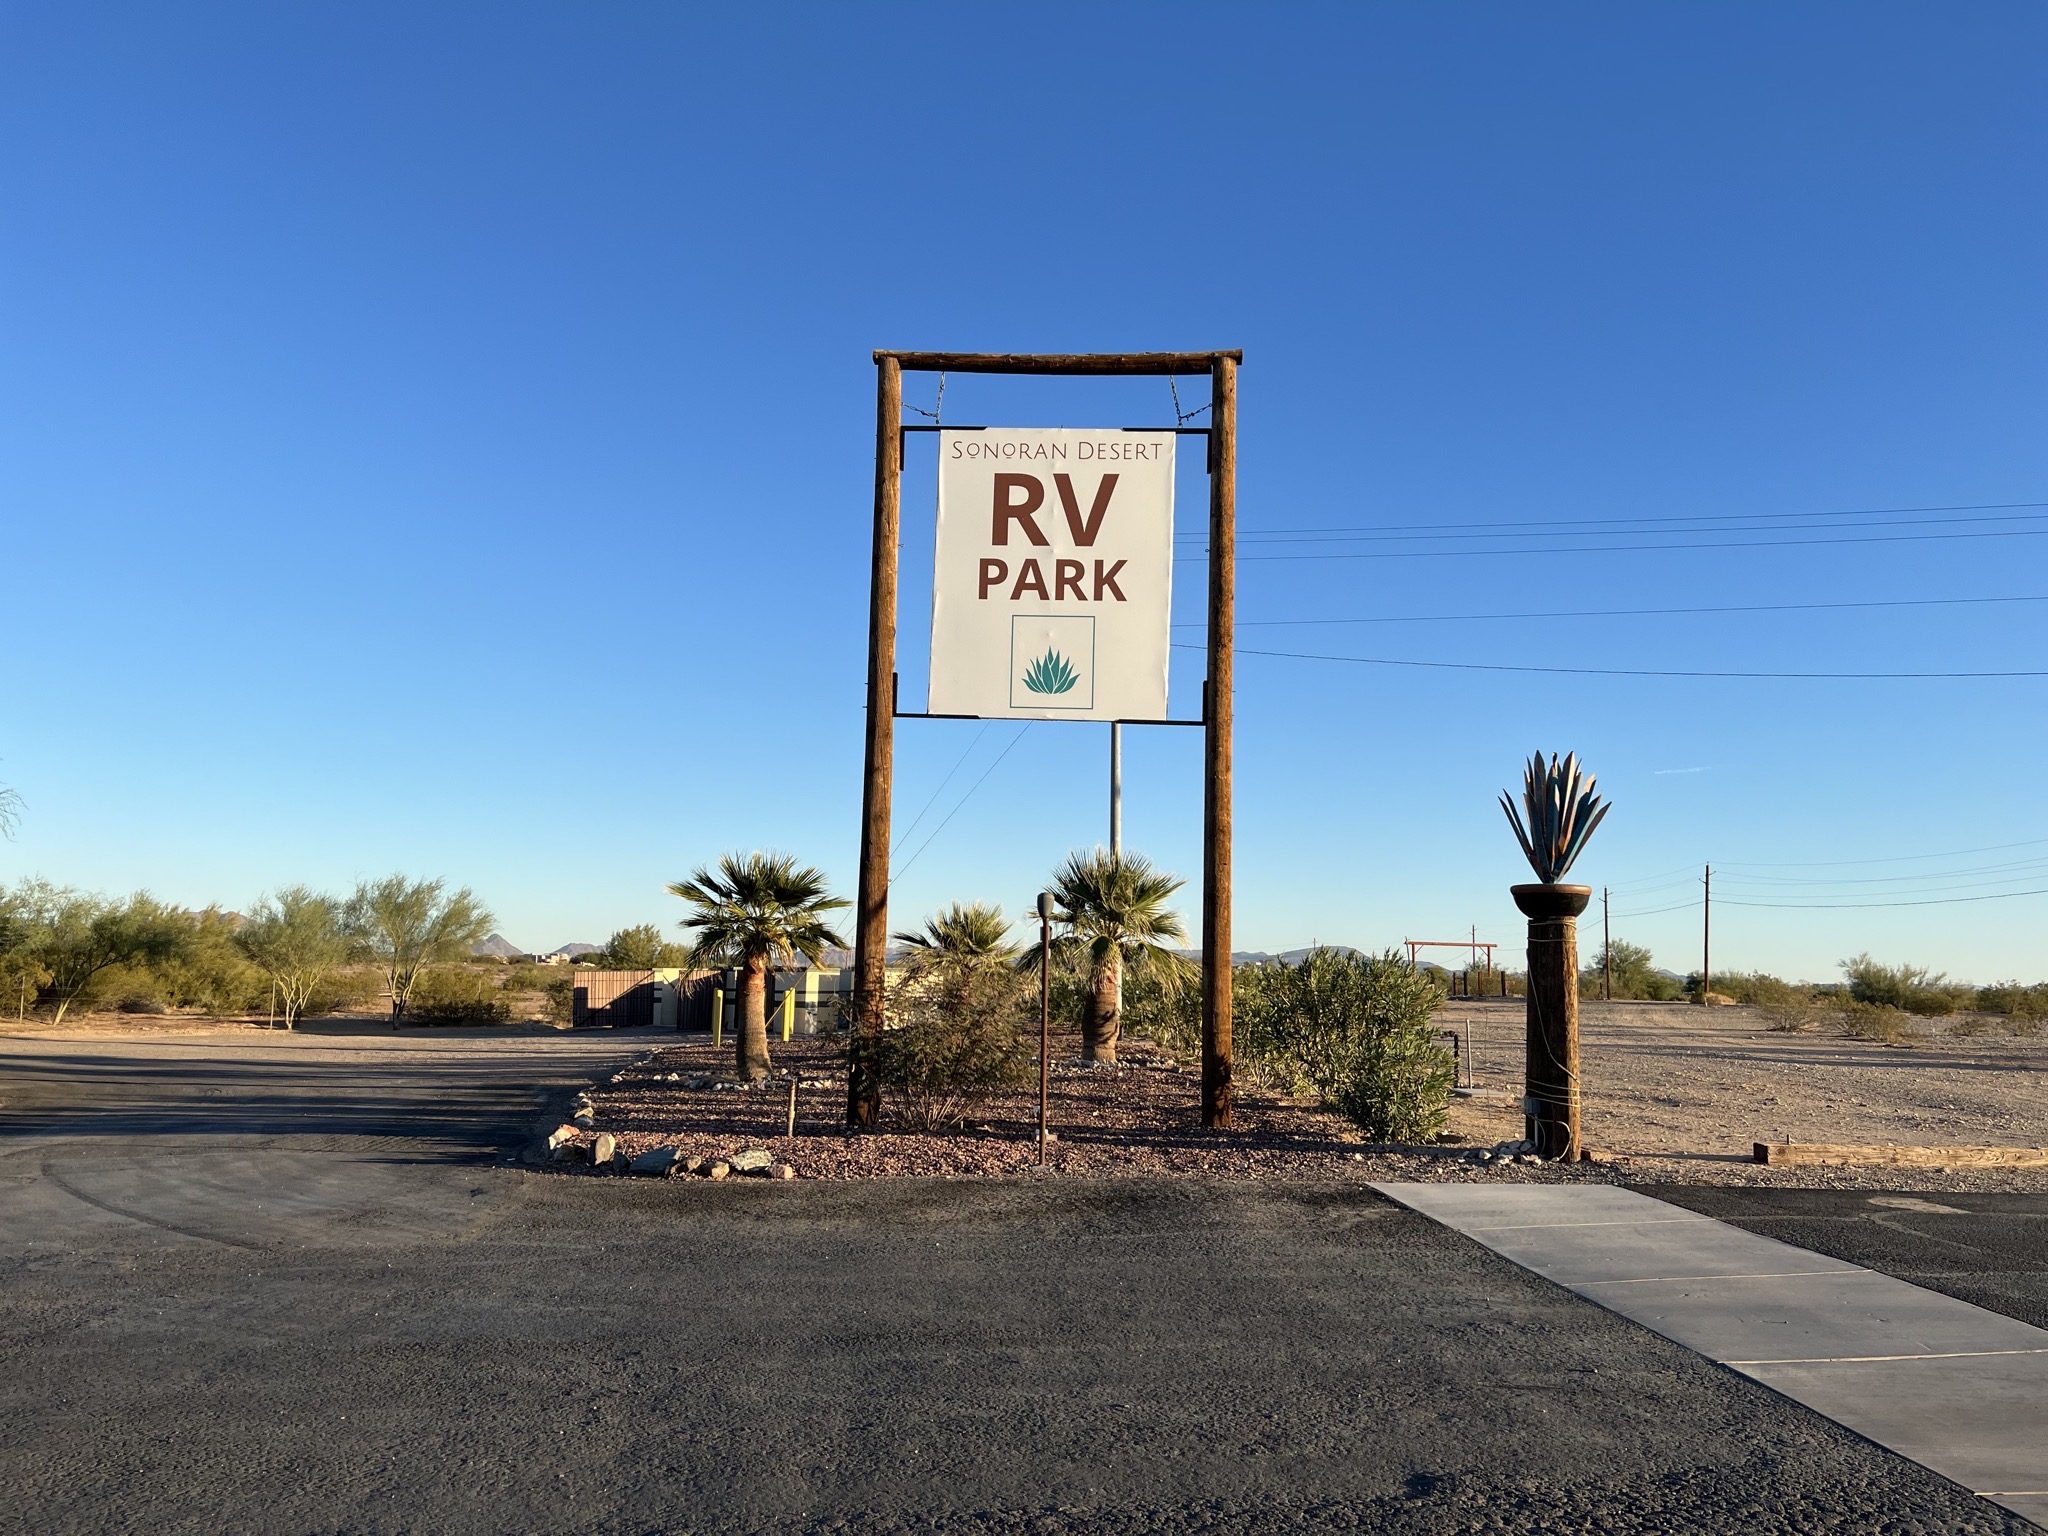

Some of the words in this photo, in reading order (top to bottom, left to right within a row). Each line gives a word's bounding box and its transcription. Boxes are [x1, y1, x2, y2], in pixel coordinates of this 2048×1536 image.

[951, 440, 1067, 460] SONORAN
[1078, 441, 1164, 460] DESERT
[991, 472, 1120, 548] RV
[977, 557, 1129, 602] PARK
